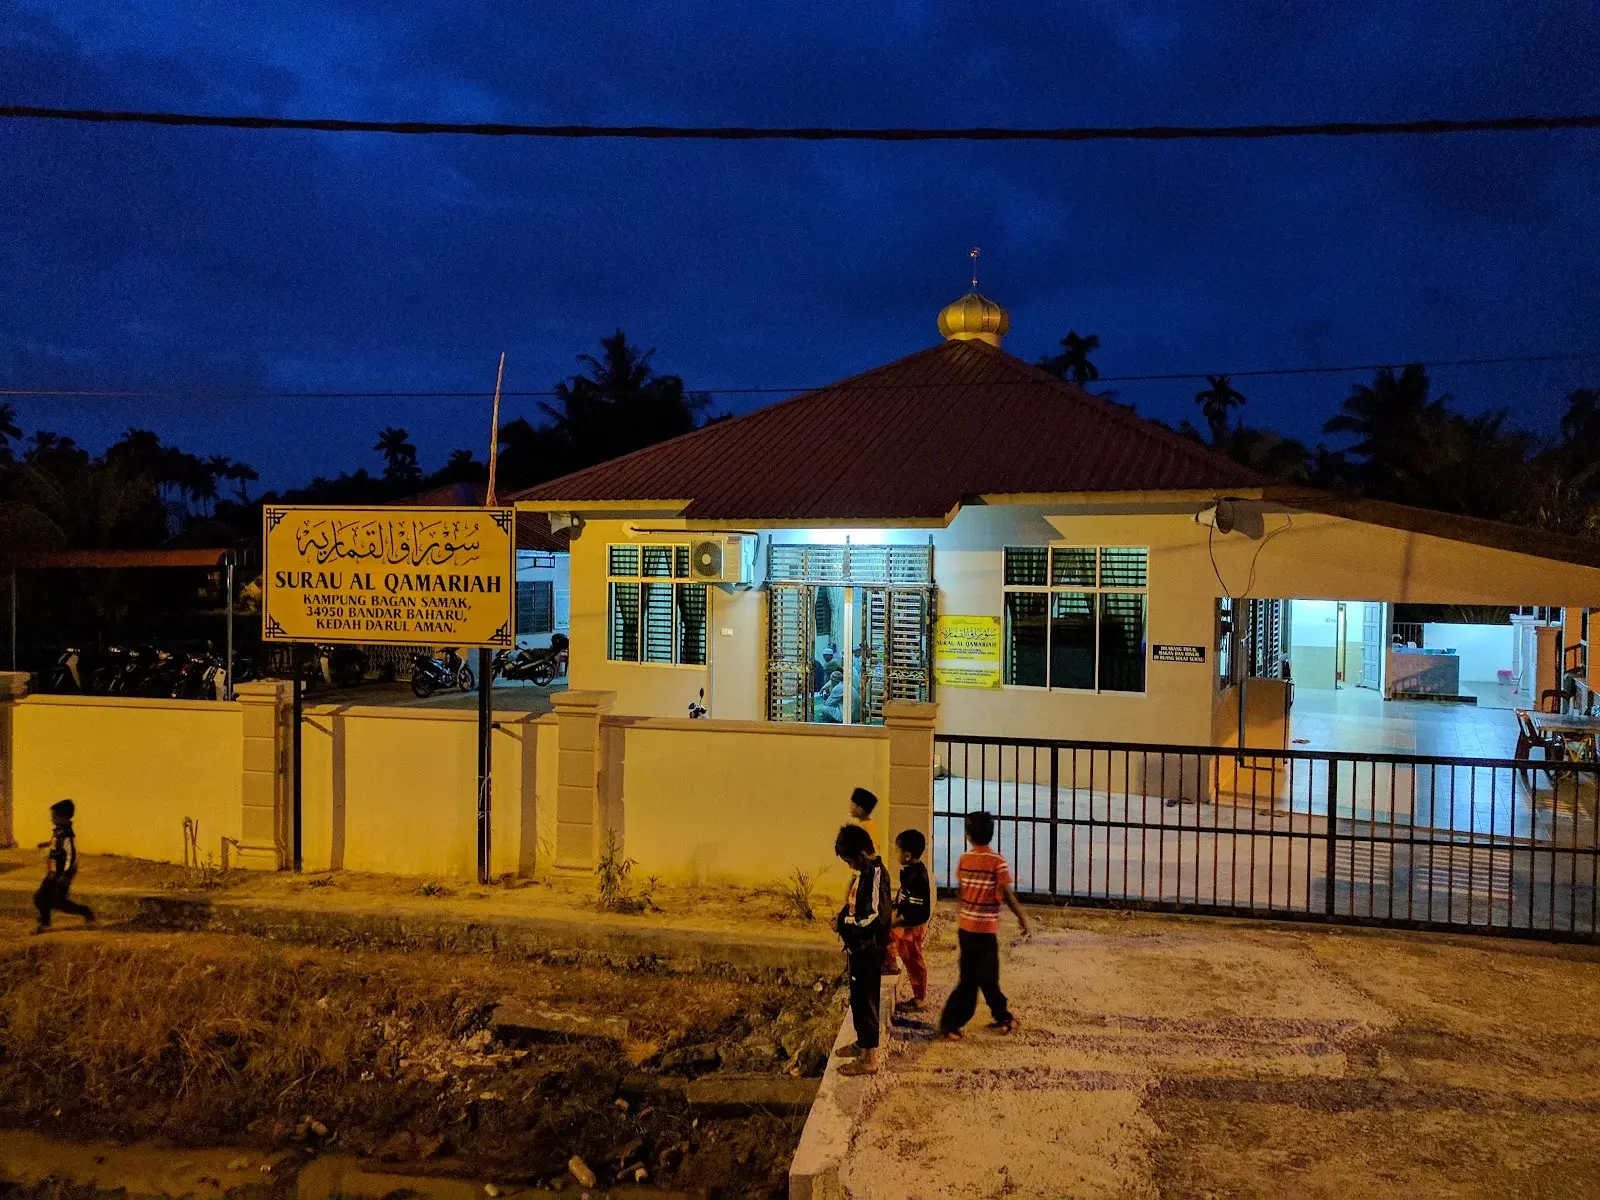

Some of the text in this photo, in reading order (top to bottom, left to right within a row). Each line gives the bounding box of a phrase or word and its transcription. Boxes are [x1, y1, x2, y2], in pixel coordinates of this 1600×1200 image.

[275, 571, 501, 594] SURAU AL QAMARIAH
[303, 594, 472, 610] KAMPUNG BAGAN SAMAK,
[306, 606, 467, 622] 34950 BANDAR BAHARU,
[316, 619, 456, 634] KEDAH DARUL AMAN.
